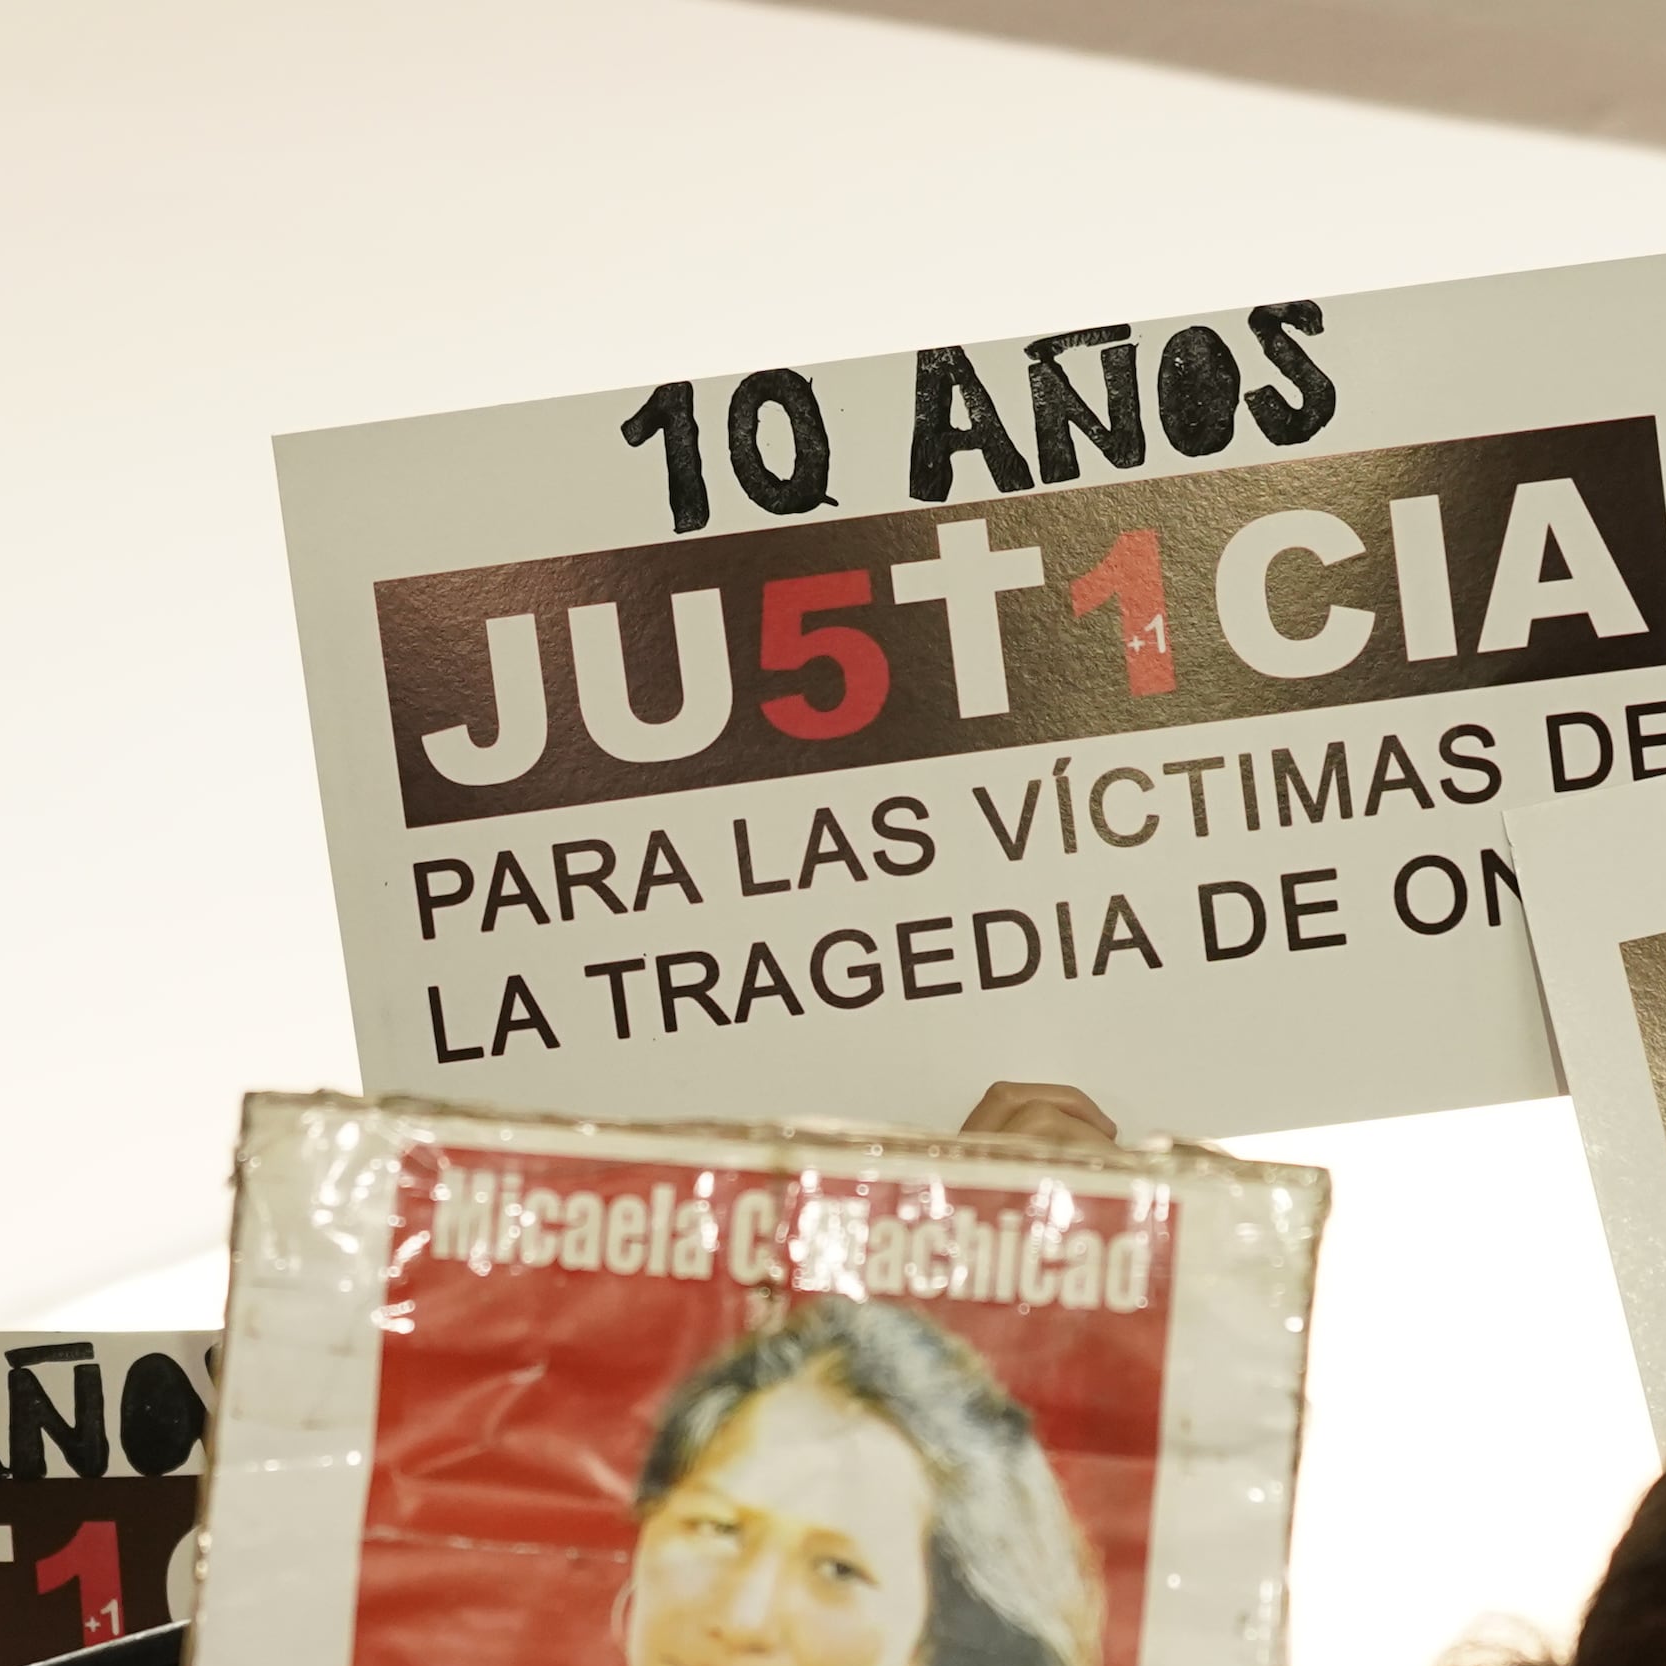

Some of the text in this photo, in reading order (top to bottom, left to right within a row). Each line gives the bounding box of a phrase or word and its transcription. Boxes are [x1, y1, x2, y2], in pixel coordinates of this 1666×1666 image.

[620, 299, 1337, 533] 10 AÑOS
[413, 829, 703, 941] PARA
[732, 795, 936, 897] LAS
[973, 723, 1503, 861] VÍCTIMAS
[428, 975, 560, 1064] LA
[585, 894, 1163, 1040] TRAGEDIA
[1197, 868, 1348, 963] DE
[434, 1166, 713, 1282] Micaela
